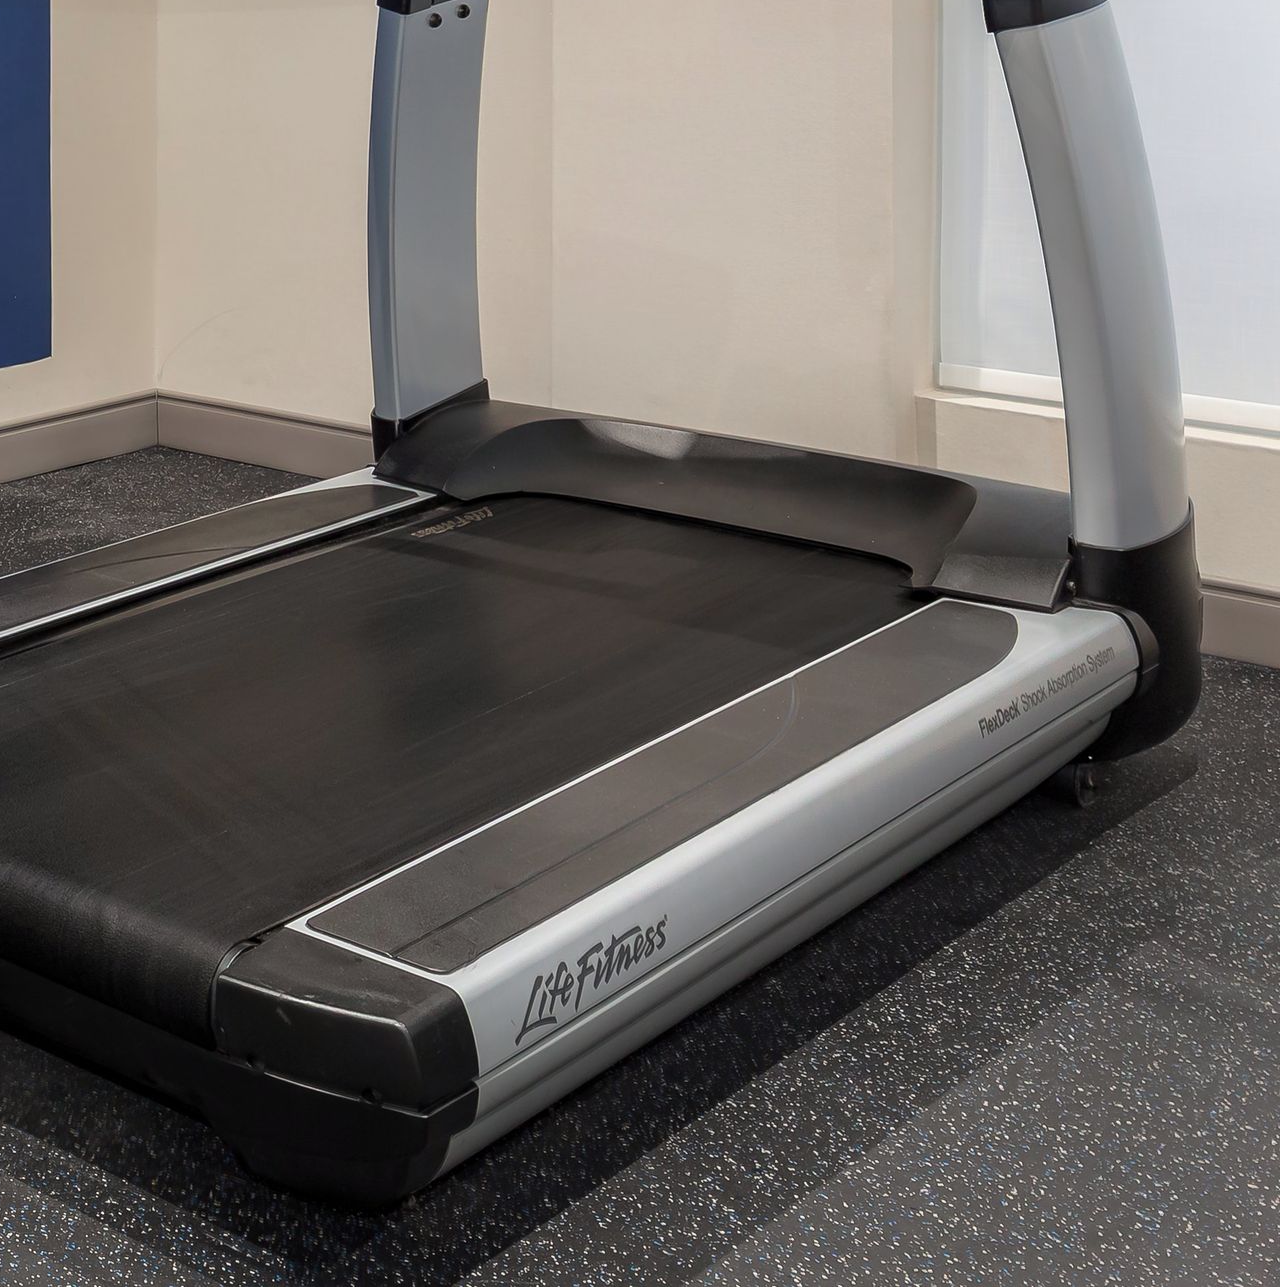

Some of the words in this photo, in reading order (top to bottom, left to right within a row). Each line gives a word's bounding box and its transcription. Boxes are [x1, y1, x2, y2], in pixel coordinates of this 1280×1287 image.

[977, 697, 1021, 739] FlexDeck
[1020, 684, 1047, 712] Shock
[1047, 661, 1087, 696] Absorption
[1086, 645, 1116, 675] System
